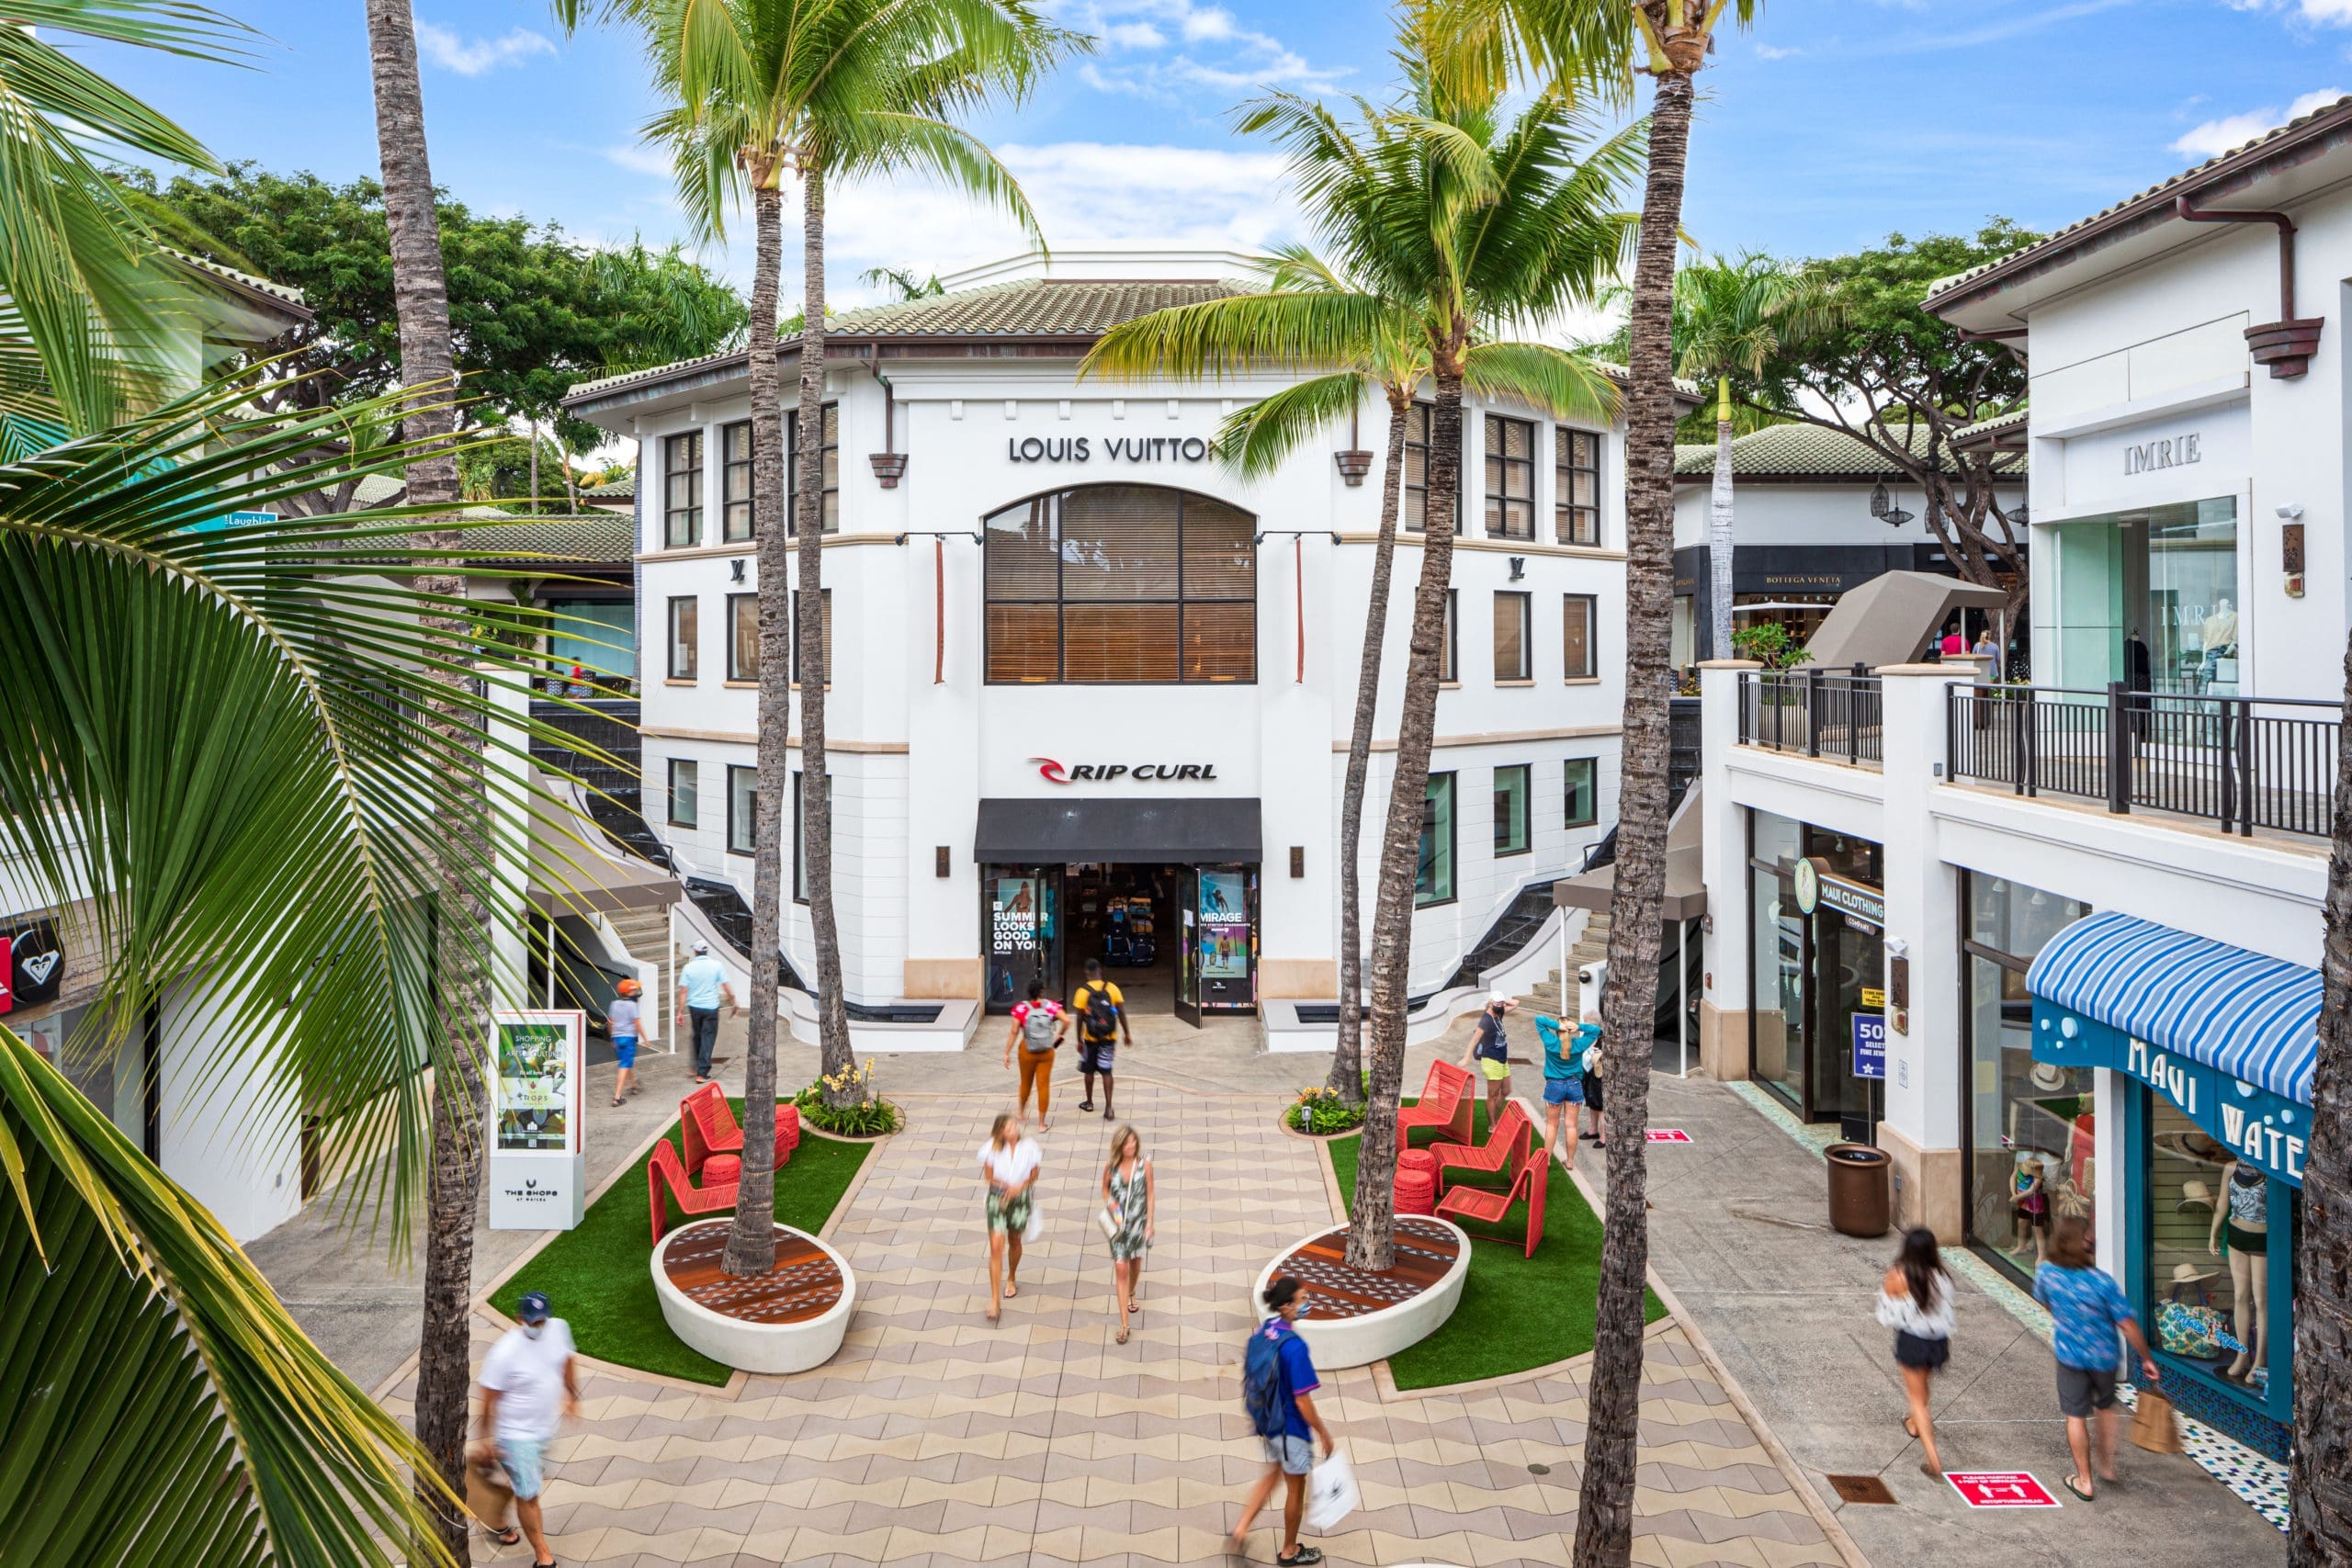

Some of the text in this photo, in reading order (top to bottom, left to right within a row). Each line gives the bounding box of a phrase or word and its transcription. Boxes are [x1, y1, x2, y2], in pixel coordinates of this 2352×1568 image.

[1009, 437, 1091, 461] LOUIS
[2124, 433, 2201, 476] IMRIE
[1766, 576, 1841, 584] BOTTEGA VENETA
[1070, 764, 1218, 780] RIP CURL
[1821, 883, 1885, 918] MAUI CLOTHING
[1200, 912, 1242, 922] MIRAGE
[993, 921, 1035, 931] LOOKS
[1848, 918, 1871, 932] COMPANY
[993, 931, 1031, 941] GOOD
[993, 940, 1012, 951] ON
[1860, 1023, 1885, 1040] 50
[1860, 1048, 1872, 1056] FINE
[2128, 1037, 2305, 1180] MAUI WATE
